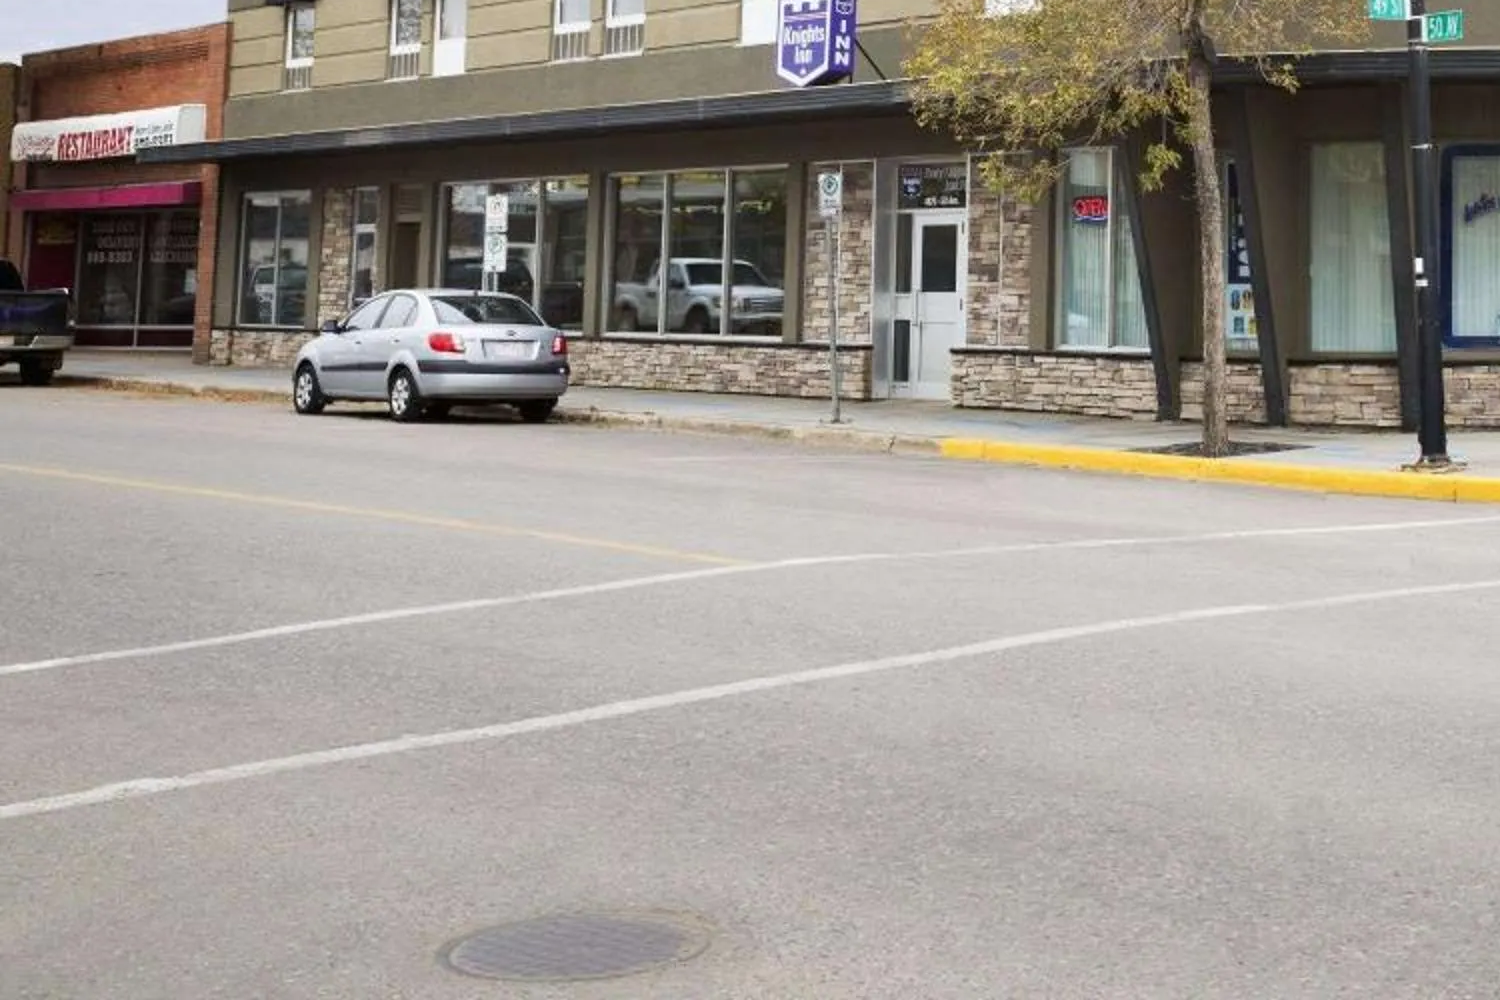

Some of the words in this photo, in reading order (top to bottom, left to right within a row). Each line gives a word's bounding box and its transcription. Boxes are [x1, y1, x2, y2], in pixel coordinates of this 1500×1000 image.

[783, 24, 824, 48] Knights
[1429, 16, 1443, 38] 50
[795, 45, 813, 65] Inn
[834, 19, 851, 67] INN
[57, 125, 135, 160] RESTAURANT
